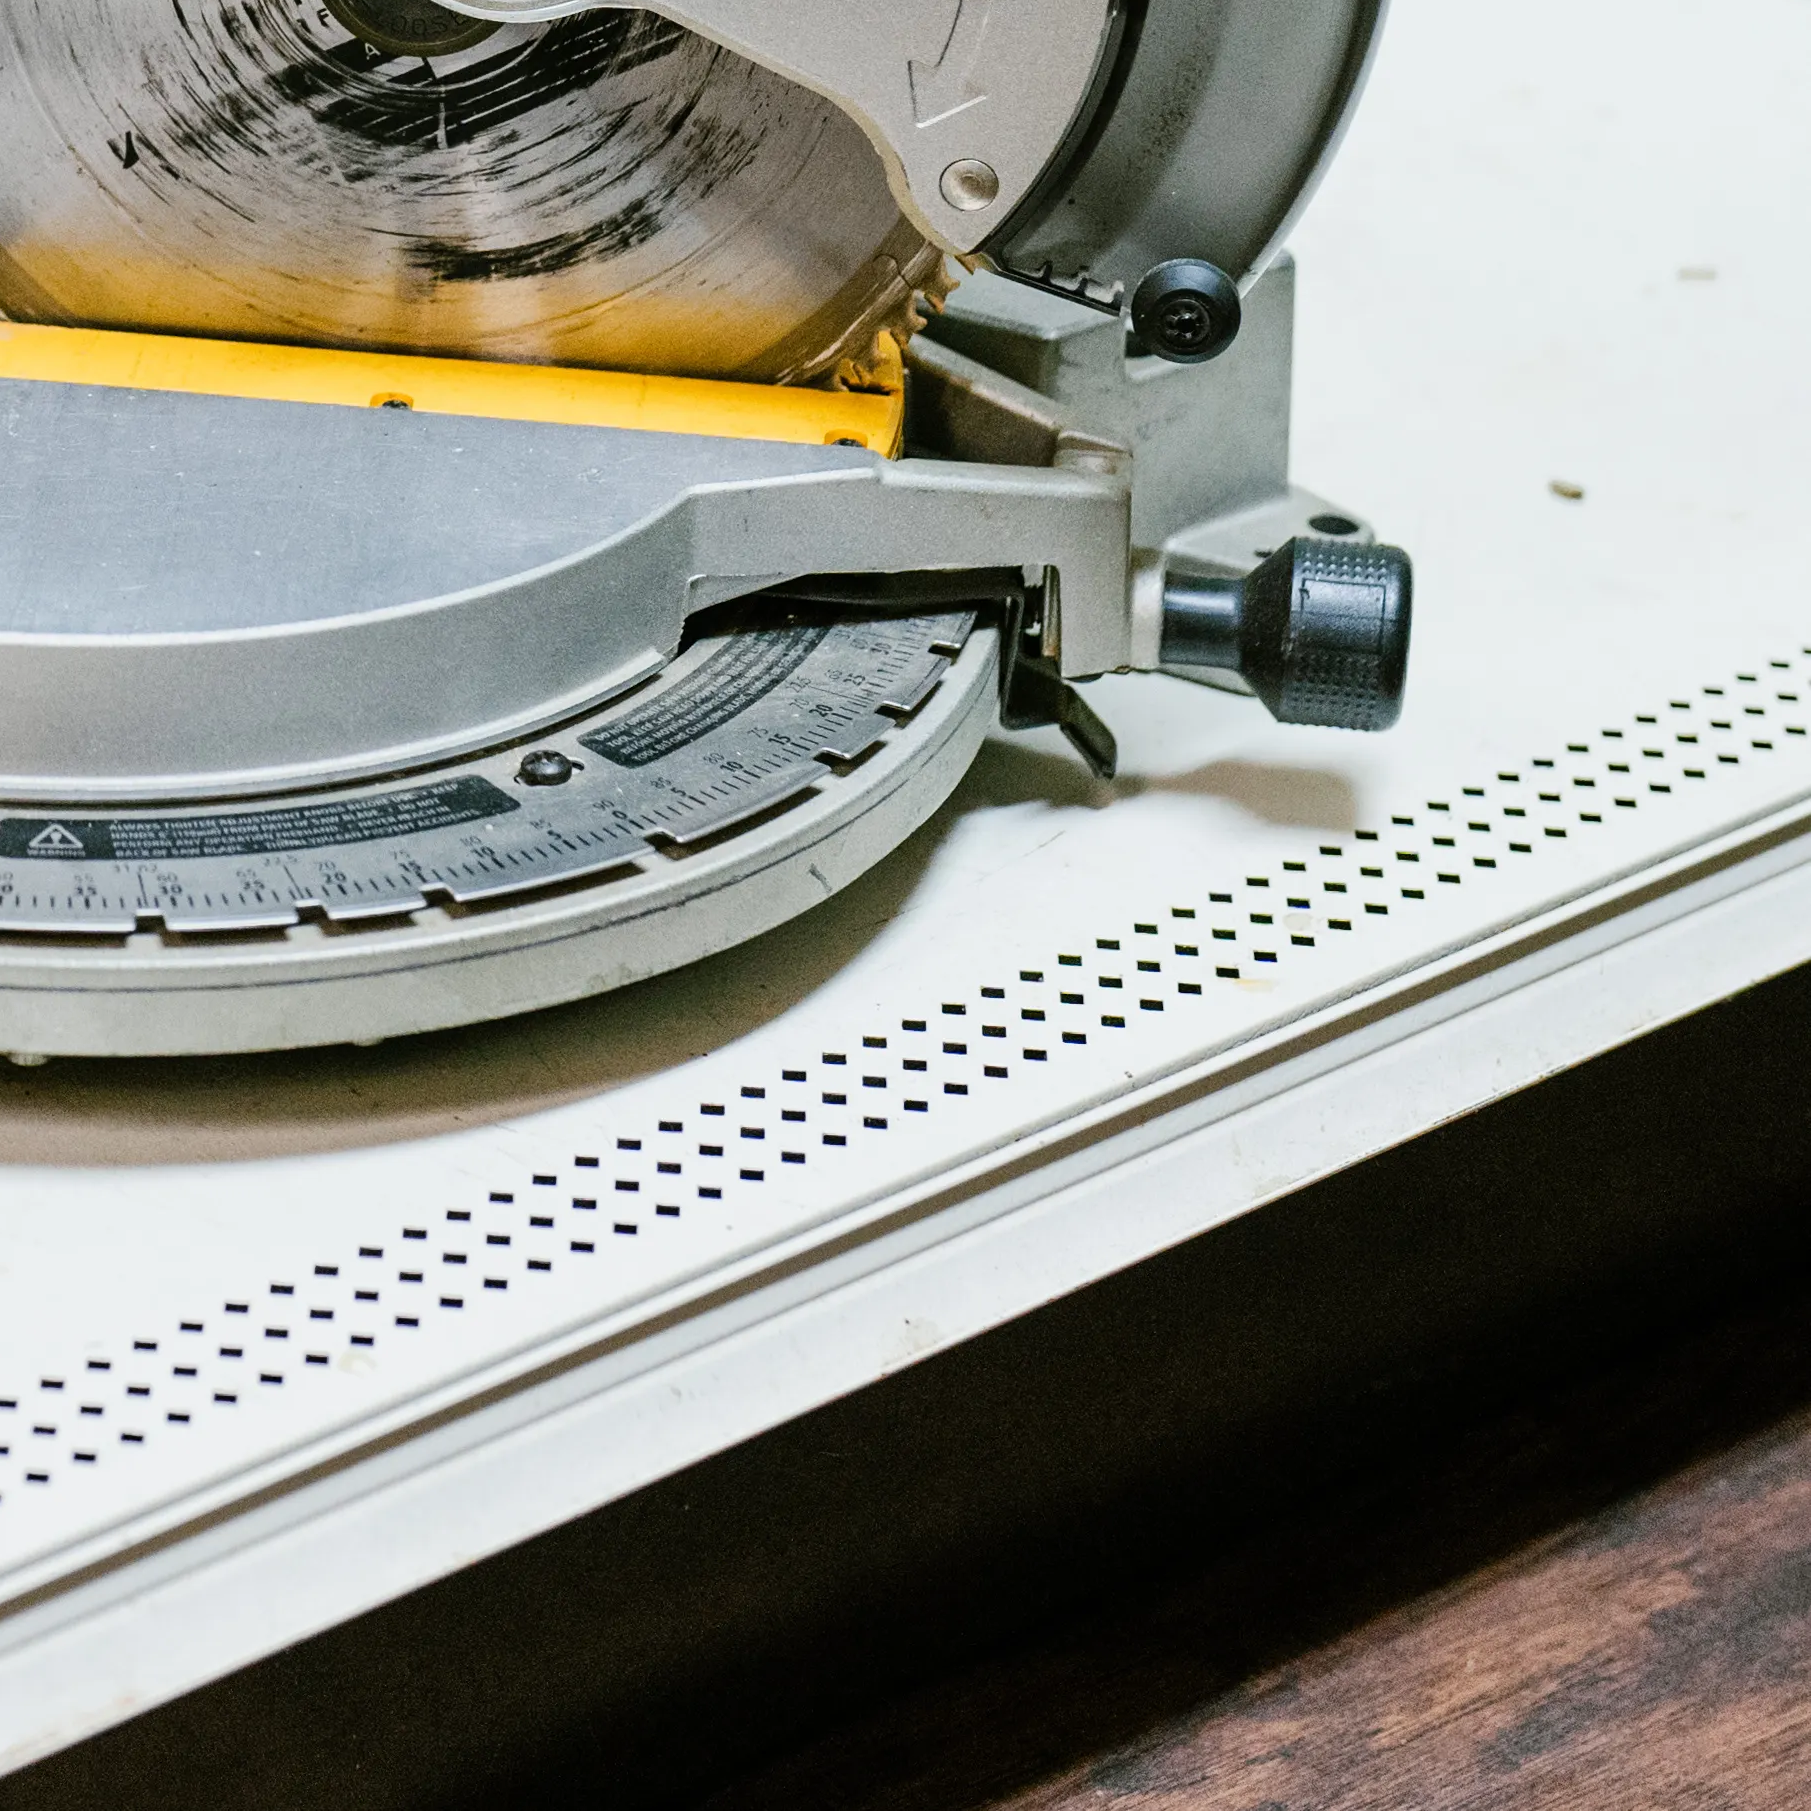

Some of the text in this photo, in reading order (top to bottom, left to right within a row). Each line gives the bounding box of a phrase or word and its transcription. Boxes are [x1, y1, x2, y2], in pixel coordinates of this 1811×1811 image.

[808, 704, 834, 718] 20
[767, 732, 792, 746] 15
[719, 760, 745, 774] 10
[670, 786, 688, 799] 5
[260, 822, 291, 831] PATH
[293, 819, 308, 827] OF
[415, 796, 440, 808] NOT
[612, 809, 629, 820] 0
[109, 821, 160, 832] ALWAYS
[164, 819, 216, 829] TIGHTEN
[218, 812, 300, 825] ADJUSTMENT
[176, 837, 200, 846] ANY
[358, 814, 396, 829] NEVER
[470, 846, 496, 860] 10
[322, 872, 347, 884] 20
